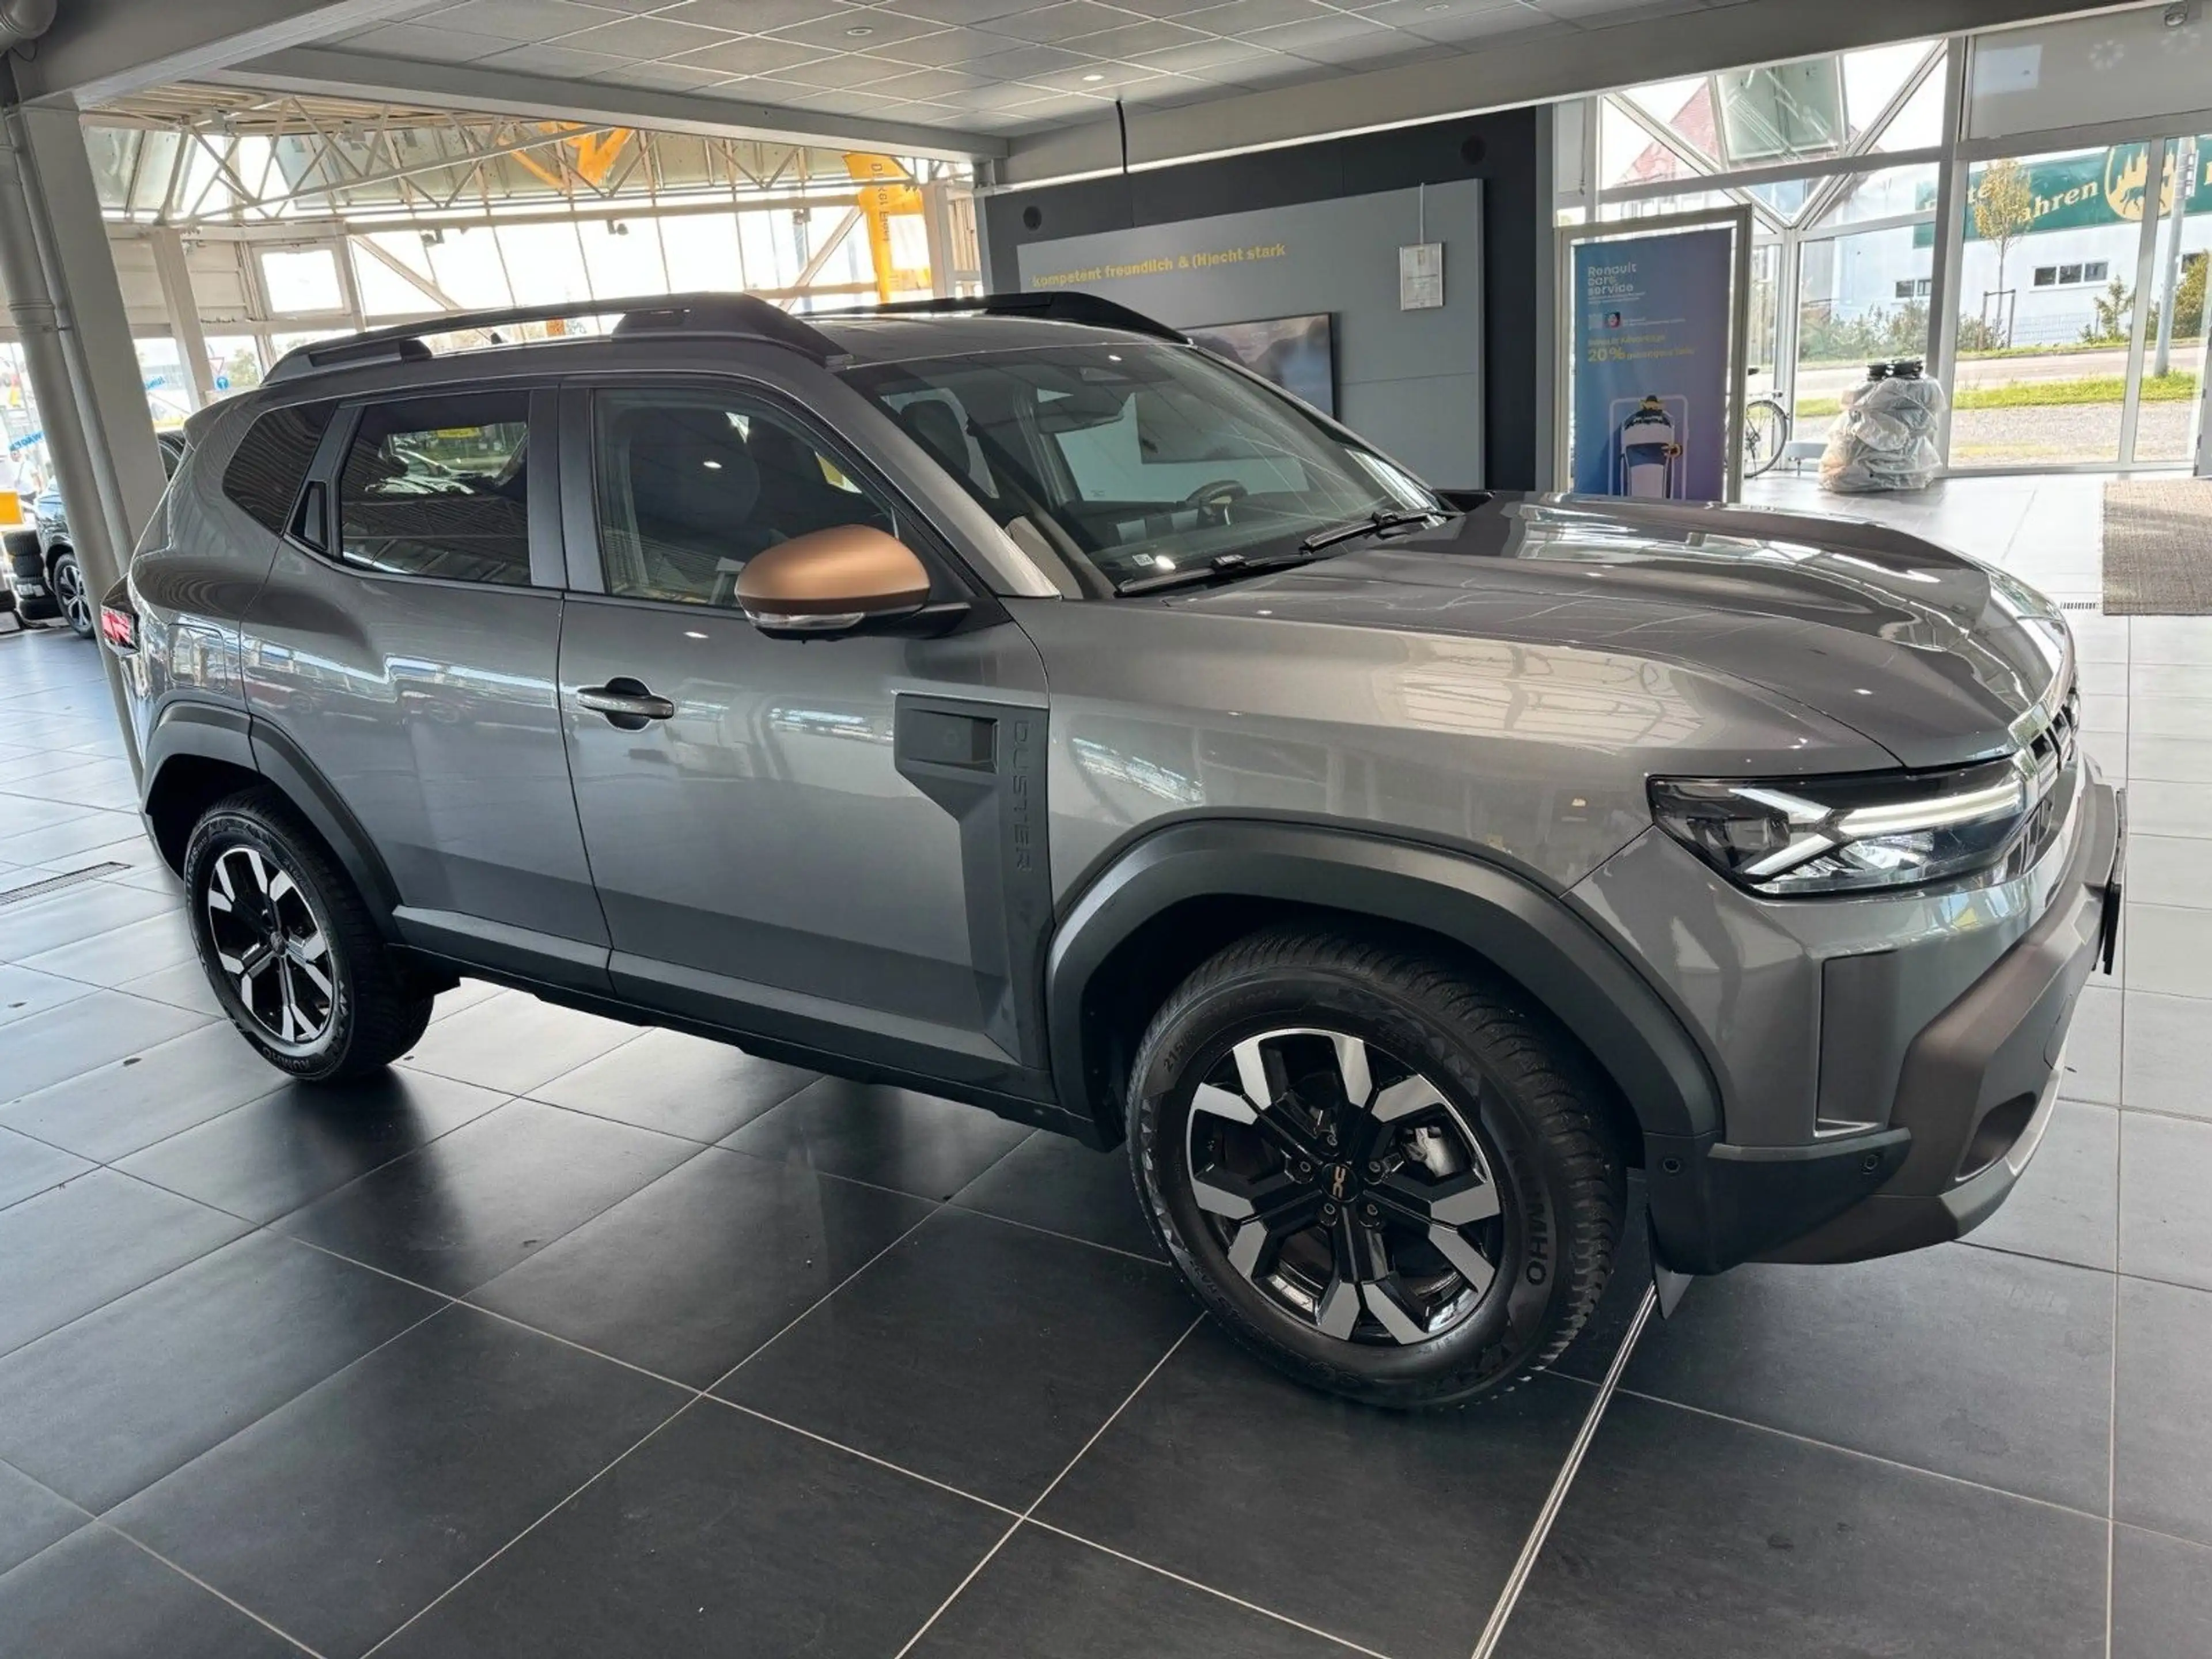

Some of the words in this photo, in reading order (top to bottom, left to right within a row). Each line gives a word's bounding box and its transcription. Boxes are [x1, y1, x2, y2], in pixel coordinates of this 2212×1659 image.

[1032, 268, 1102, 287] kompetent
[1105, 256, 1173, 278] freundlich
[1179, 256, 1190, 268] &
[1192, 247, 1244, 269] (H)echt
[1246, 243, 1286, 260] stark
[1588, 262, 1637, 277] Renault
[1012, 719, 1032, 872] DUSTER
